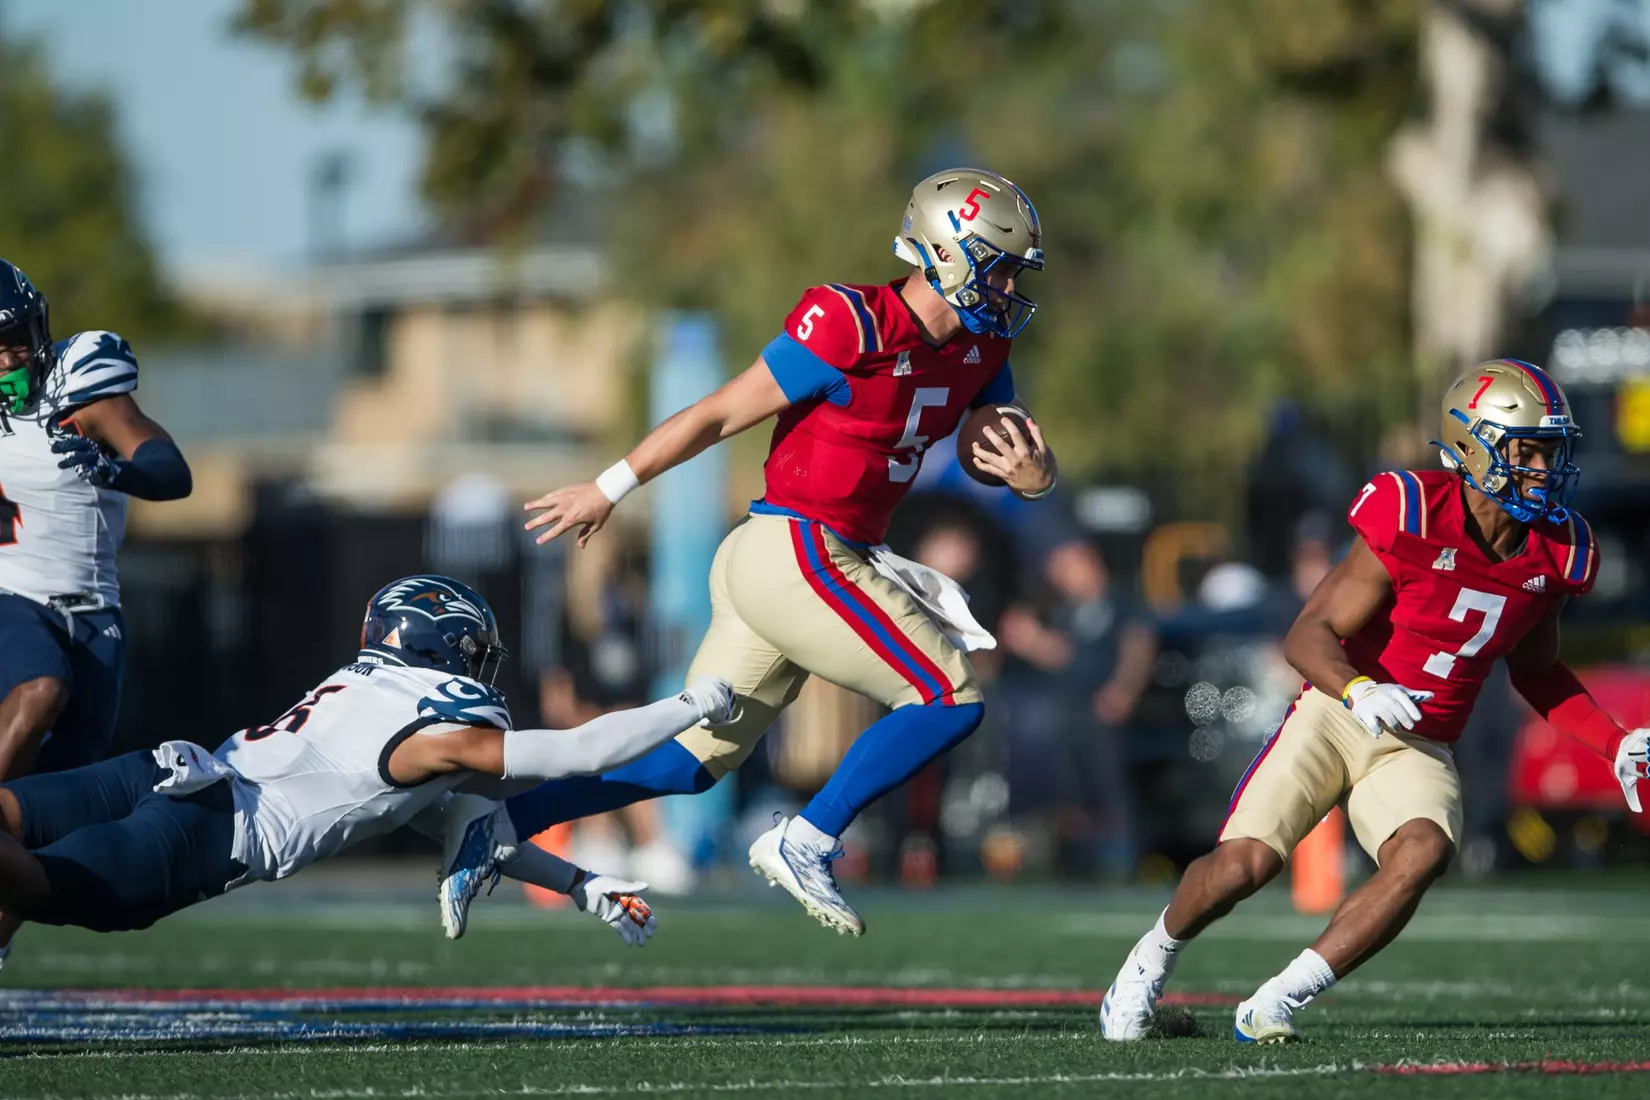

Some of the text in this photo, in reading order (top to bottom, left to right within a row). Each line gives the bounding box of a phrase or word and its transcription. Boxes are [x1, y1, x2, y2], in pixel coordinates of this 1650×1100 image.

[960, 188, 990, 221] 5
[797, 304, 824, 341] 5
[1468, 376, 1495, 409] 7
[889, 387, 950, 482] 5
[1350, 482, 1377, 517] 7
[1422, 587, 1507, 679] 7
